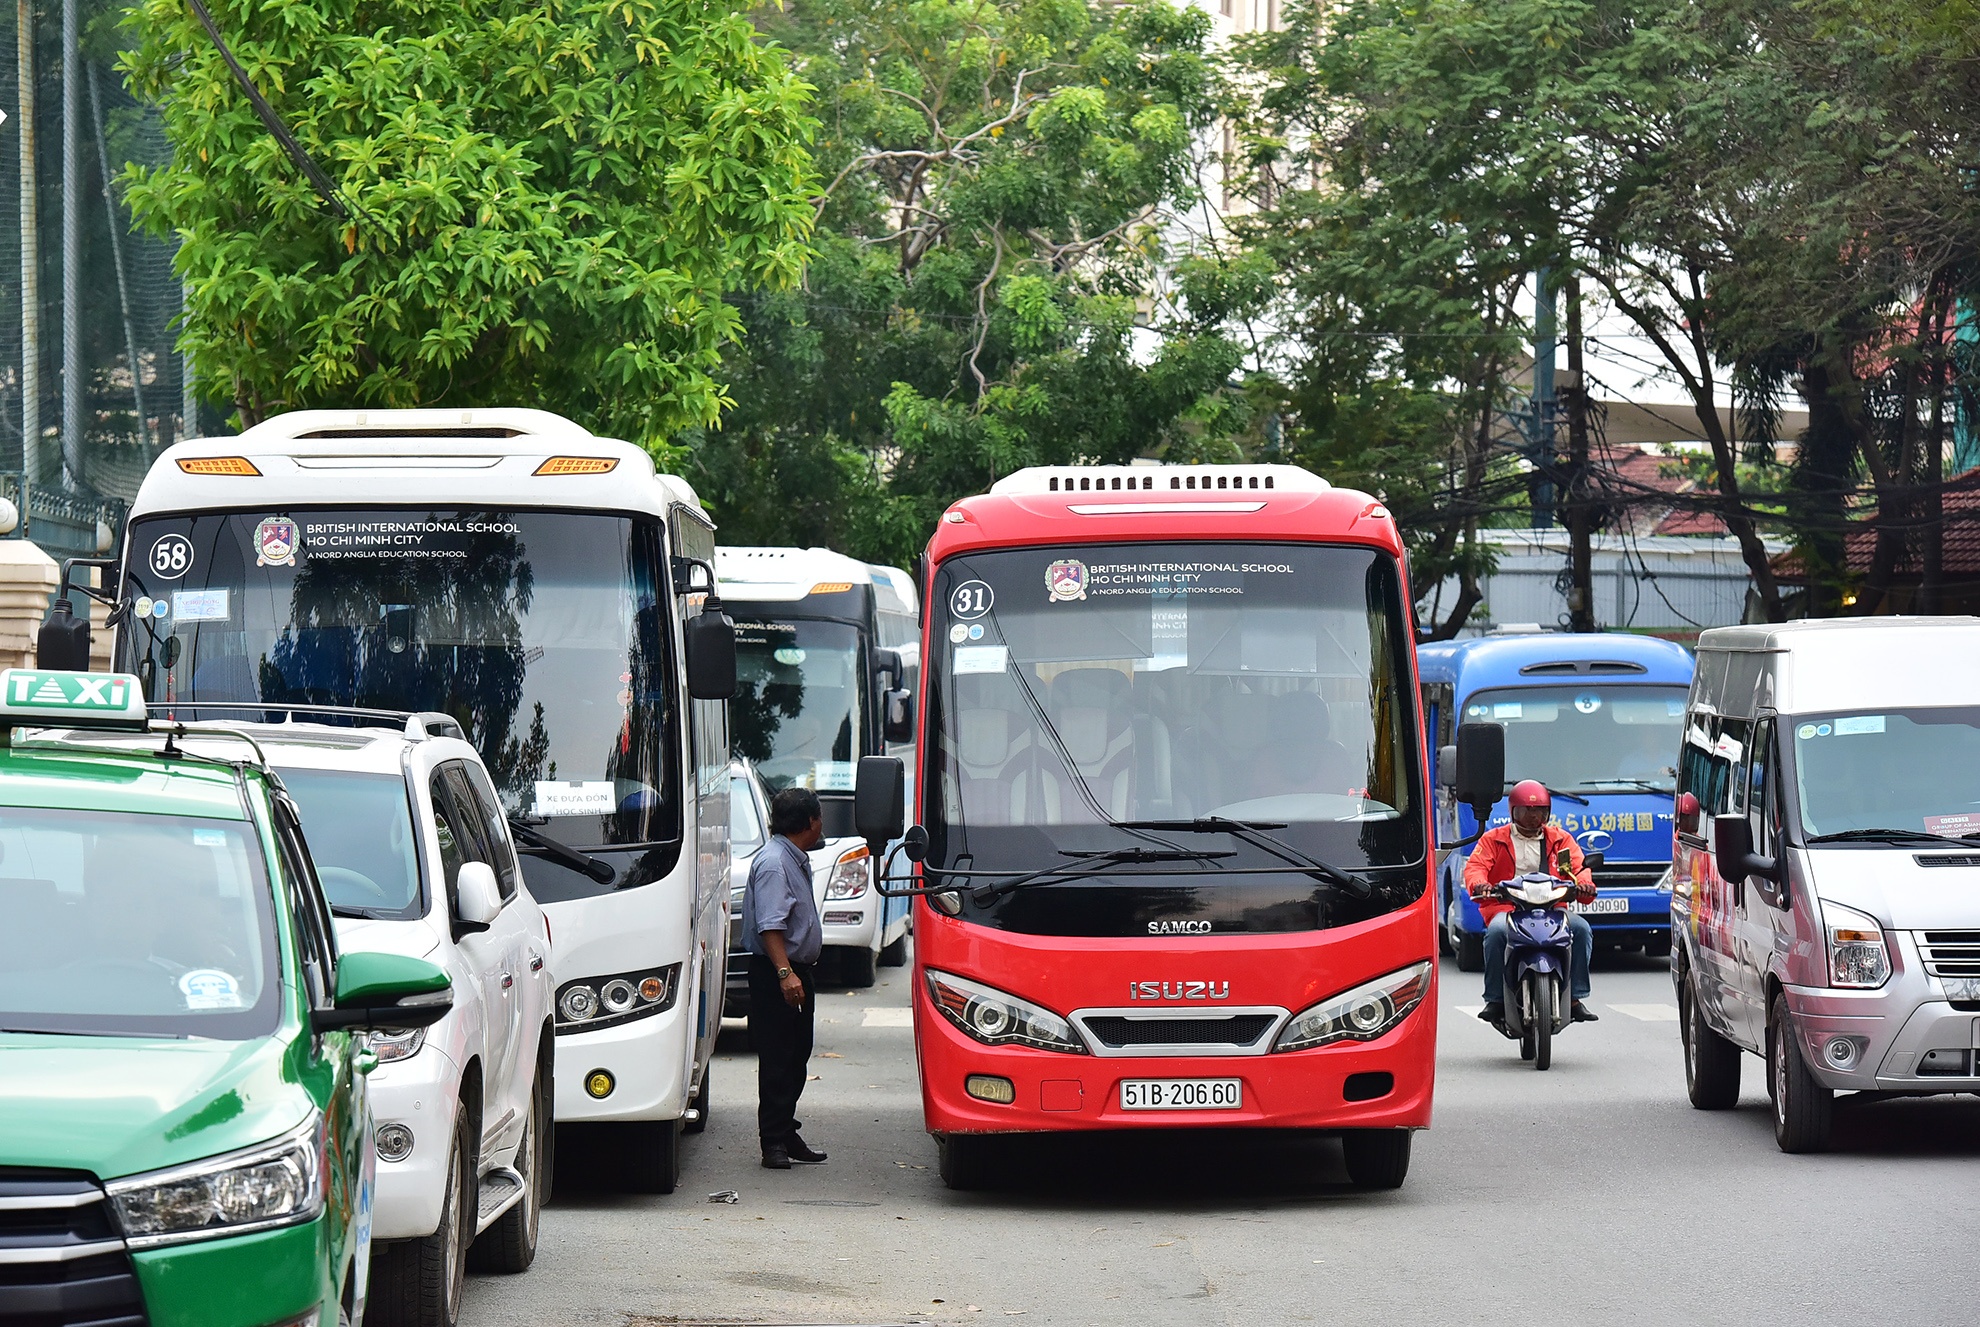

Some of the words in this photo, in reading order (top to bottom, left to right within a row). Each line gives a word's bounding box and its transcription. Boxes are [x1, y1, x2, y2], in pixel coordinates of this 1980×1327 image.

[306, 523, 357, 535] BRITISH
[357, 522, 464, 534] INTERNATIONAL
[465, 522, 521, 534] SCHOOL
[306, 535, 328, 547] HO
[329, 535, 352, 546] CHI
[355, 535, 391, 546] MINH
[393, 534, 424, 545] CITY
[155, 541, 187, 571] 58
[315, 551, 342, 559] NORD
[343, 551, 377, 559] ANGLIA
[377, 550, 430, 558] EDUCATION
[430, 550, 468, 558] SCHOOL
[1090, 564, 1137, 574] BRITISH
[1138, 563, 1239, 573] INTERNATIONAL
[1241, 563, 1294, 574] SCHOOL
[1090, 575, 1110, 585] HO
[1112, 574, 1134, 584] CHI
[1136, 574, 1171, 584] MINH
[1172, 573, 1201, 583] CITY
[1091, 588, 1099, 596] A
[1126, 587, 1157, 595] ANGLIA
[957, 587, 985, 613] 31
[766, 623, 797, 632] SCHOOL
[1582, 697, 1593, 709] 8
[546, 794, 559, 803] XE
[560, 794, 584, 803] ĐƯA
[578, 807, 602, 816] SINH
[1147, 920, 1212, 935] SAMCO
[1129, 981, 1230, 1000] ISUZU
[1125, 1083, 1238, 1106] 51B-206.60
